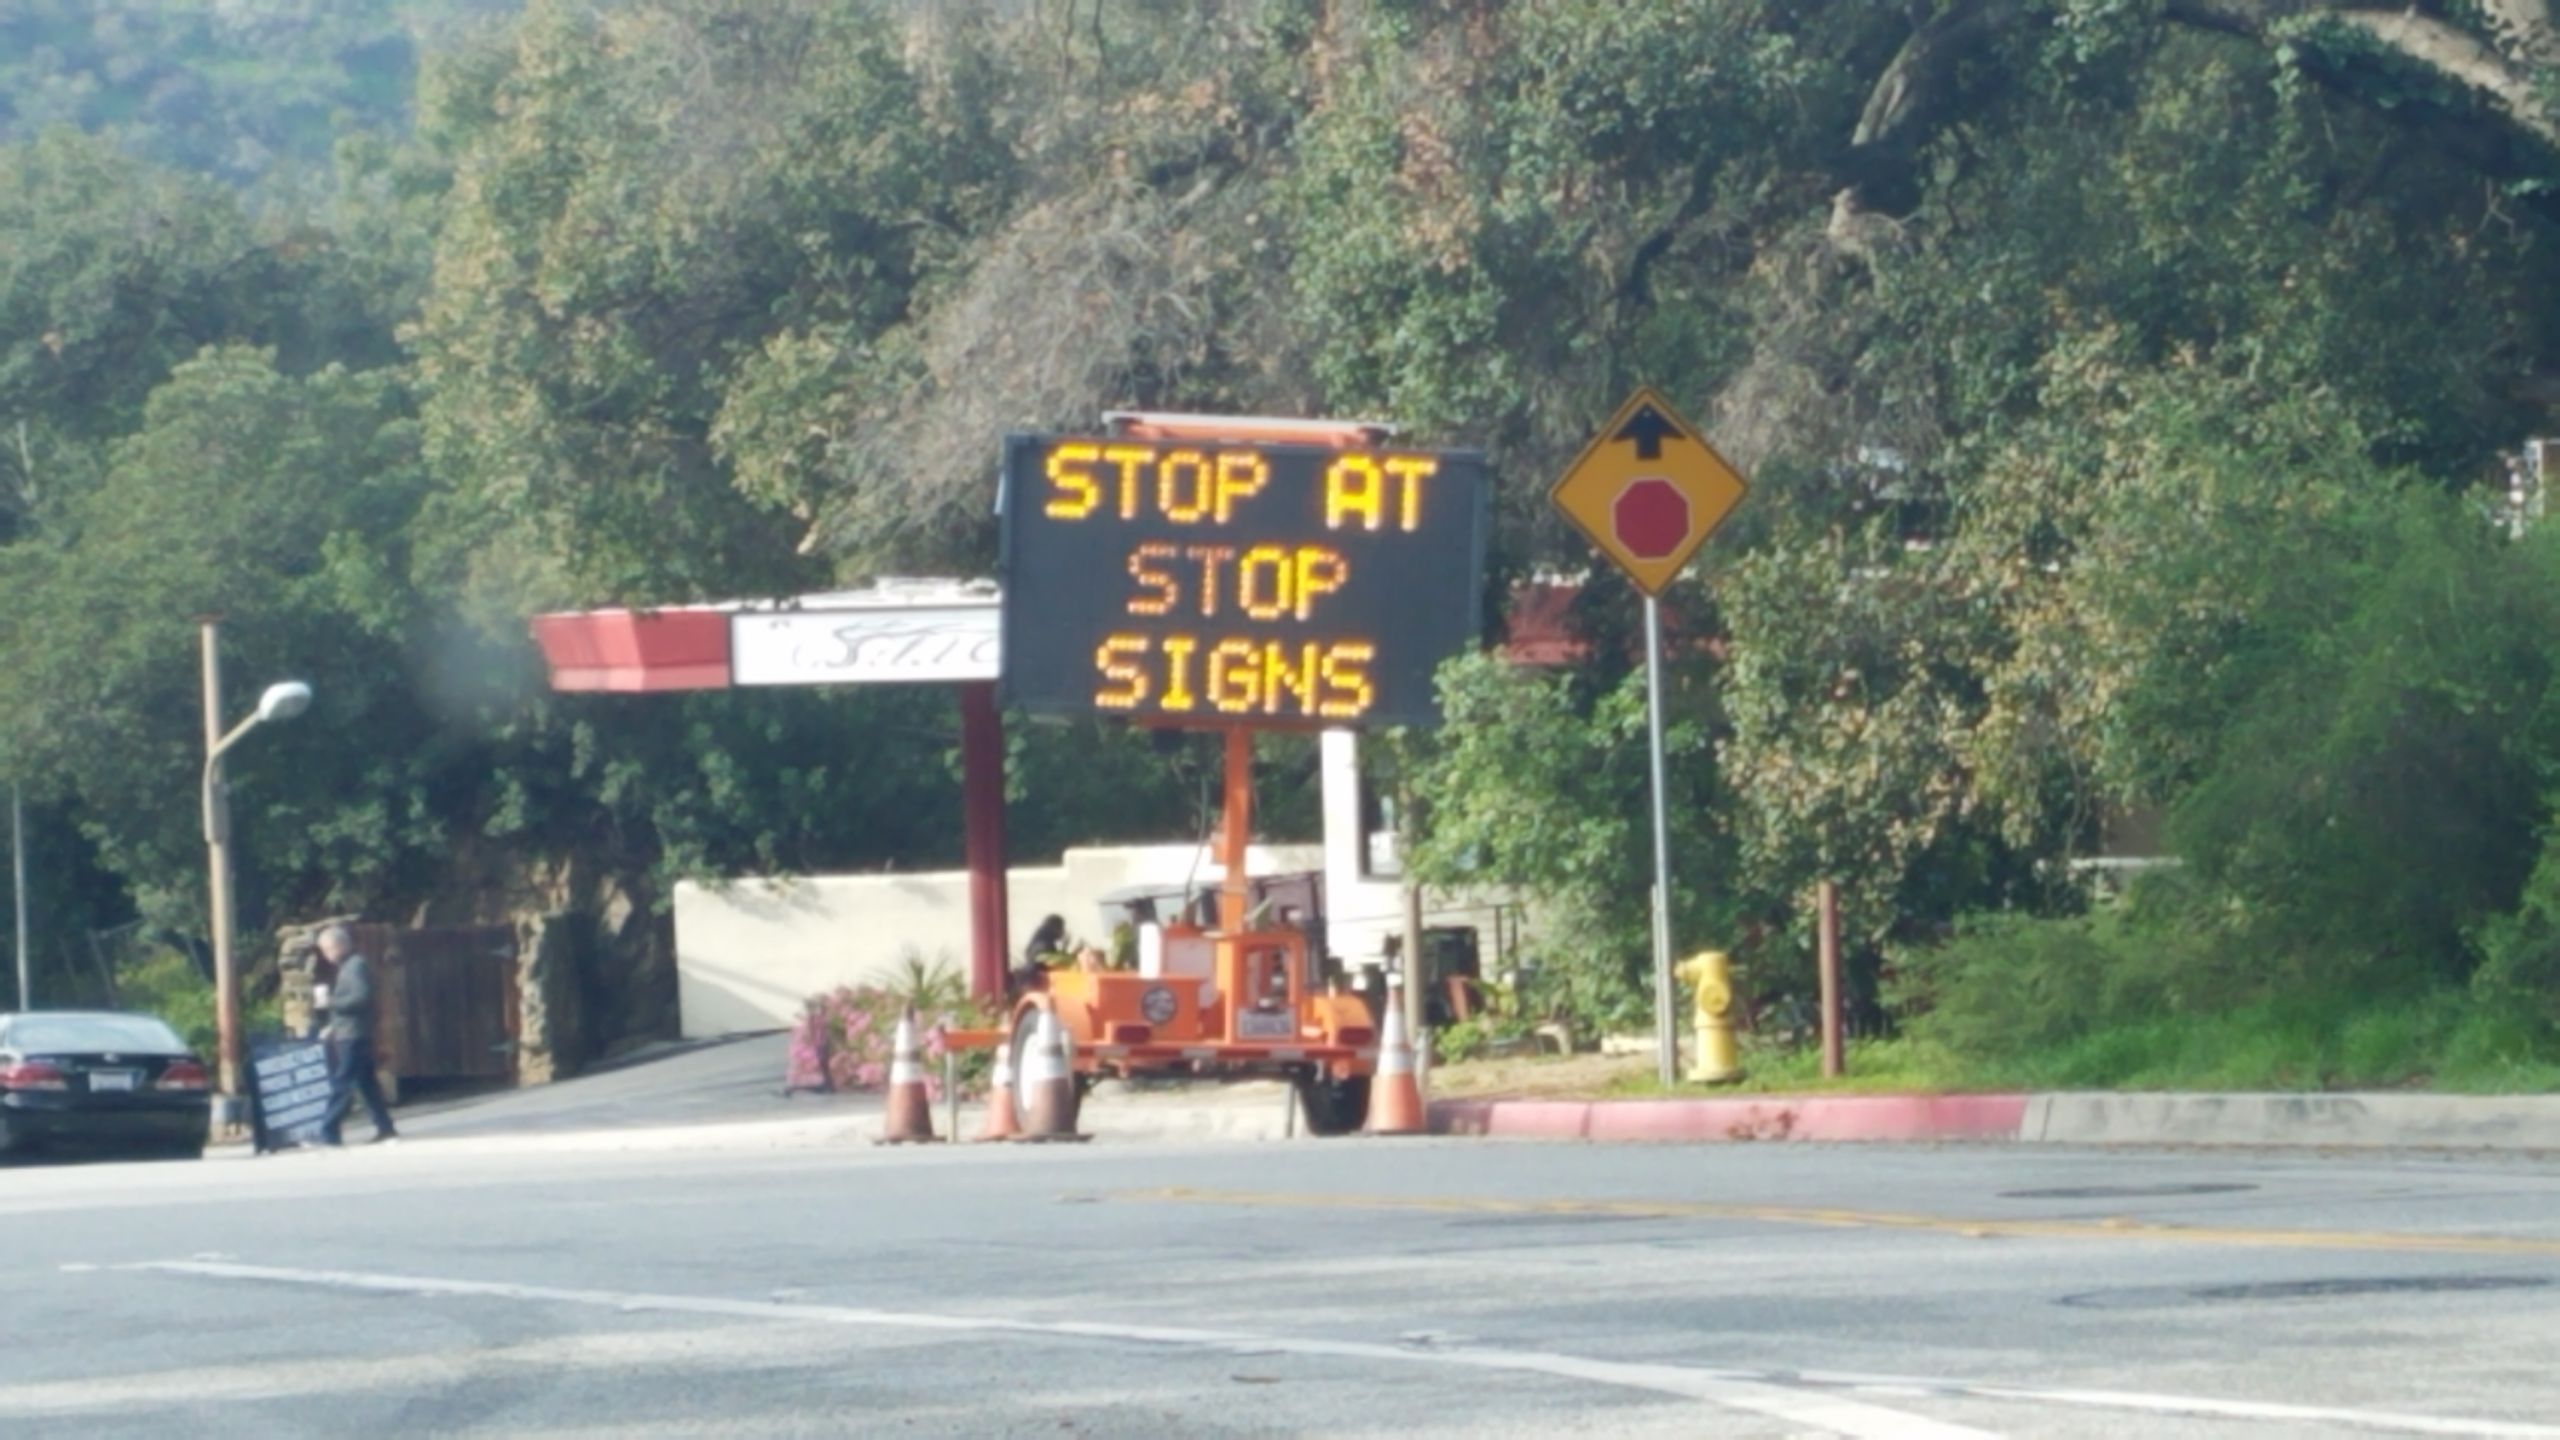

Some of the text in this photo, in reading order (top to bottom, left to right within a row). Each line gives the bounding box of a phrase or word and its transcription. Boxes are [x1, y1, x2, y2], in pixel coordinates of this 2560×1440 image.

[1045, 443, 1437, 531] STOP AT
[1127, 542, 1348, 620] STOP
[1096, 635, 1374, 717] SIGNS
